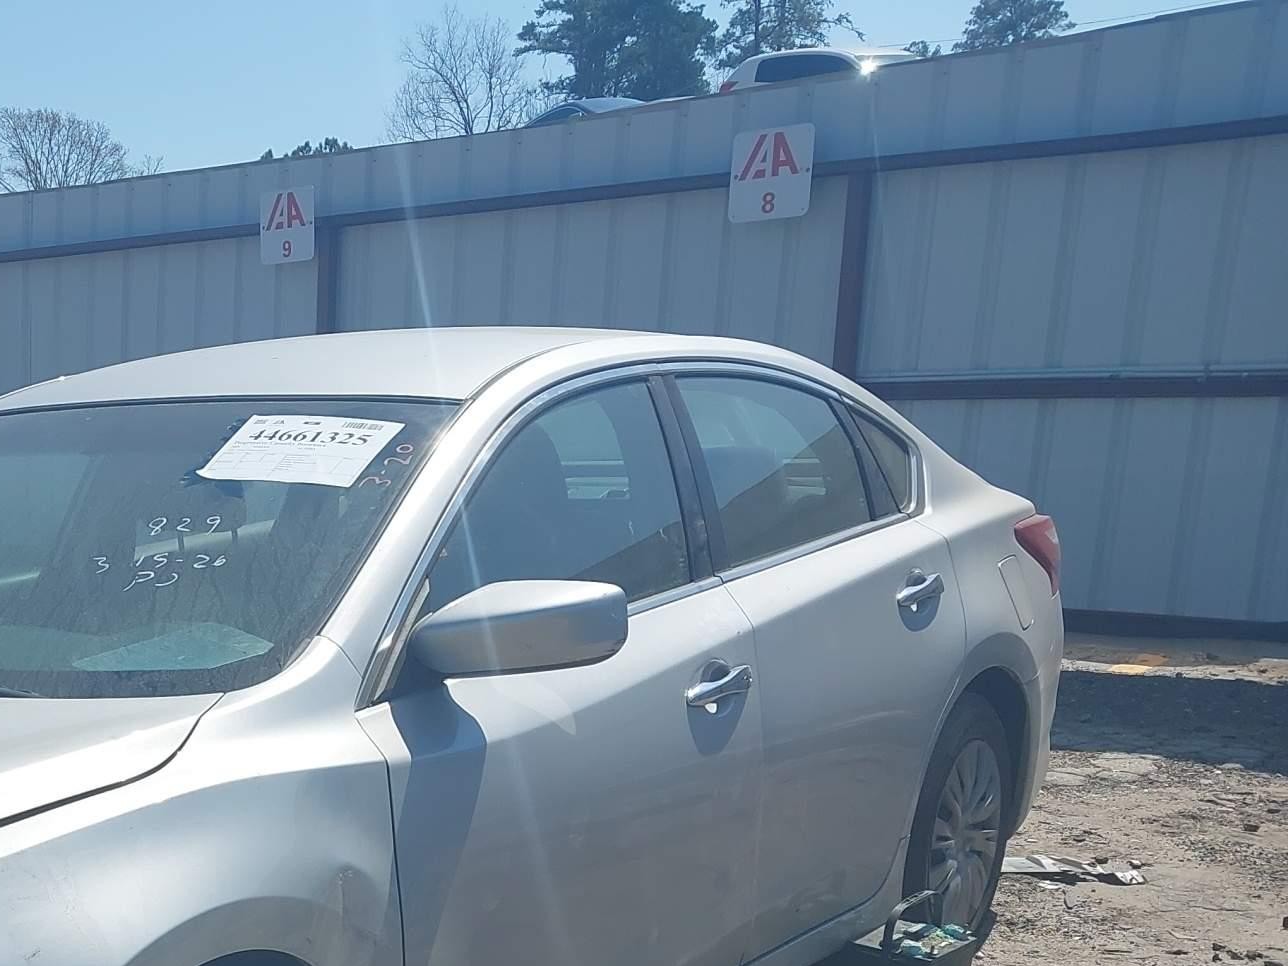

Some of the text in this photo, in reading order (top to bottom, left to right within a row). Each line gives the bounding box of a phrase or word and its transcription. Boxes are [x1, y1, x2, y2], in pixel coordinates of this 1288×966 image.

[761, 192, 775, 214] 8
[282, 240, 292, 258] 9
[248, 428, 375, 447] 44661325
